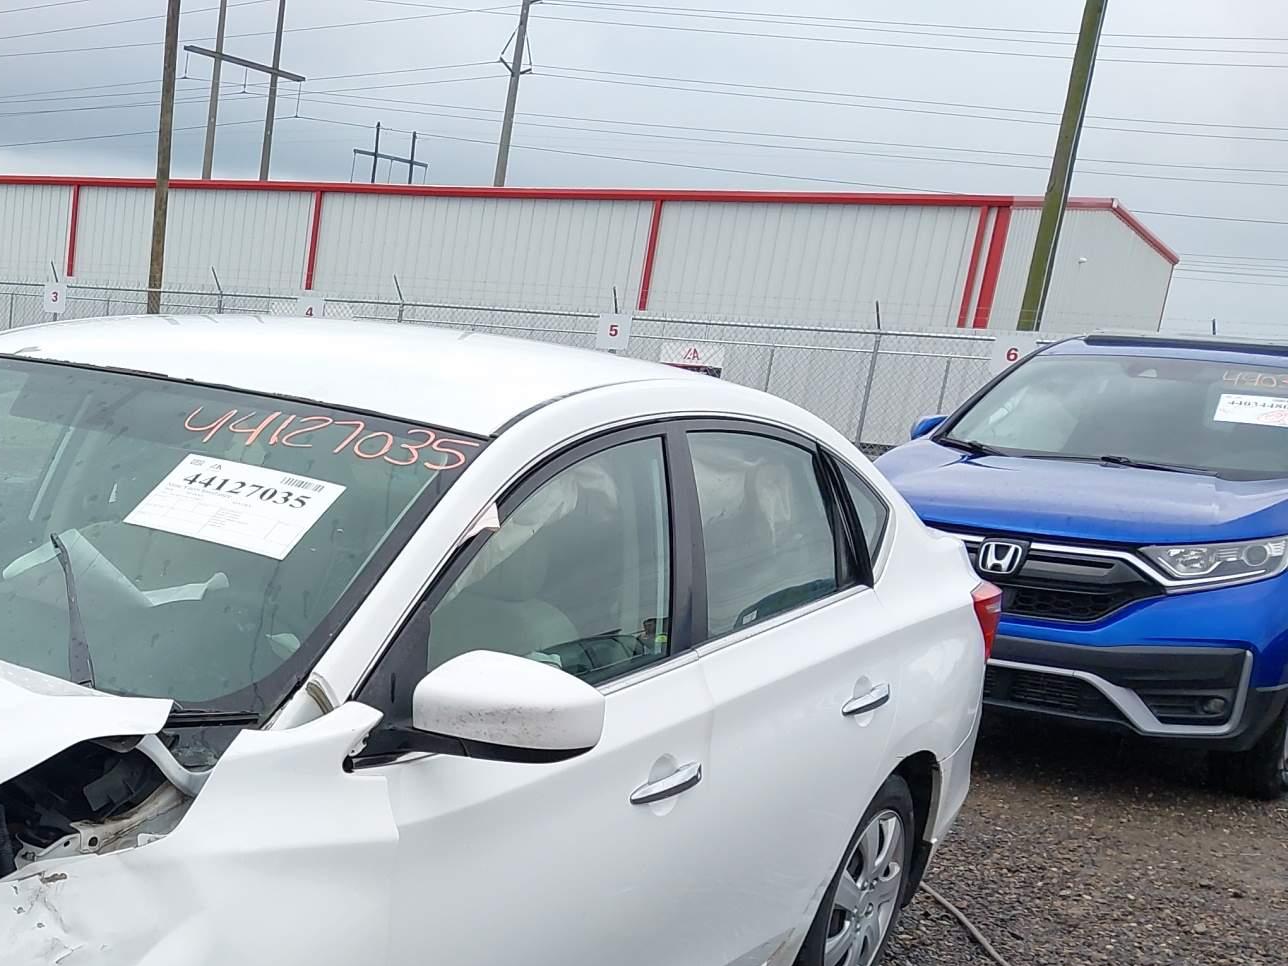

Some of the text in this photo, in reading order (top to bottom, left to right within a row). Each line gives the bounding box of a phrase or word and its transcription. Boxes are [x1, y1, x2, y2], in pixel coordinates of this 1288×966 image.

[51, 291, 59, 303] 3
[305, 306, 314, 317] 4
[609, 324, 619, 337] 5
[1006, 347, 1018, 362] 6
[184, 406, 480, 471] 44127035
[183, 472, 312, 509] 44127035
